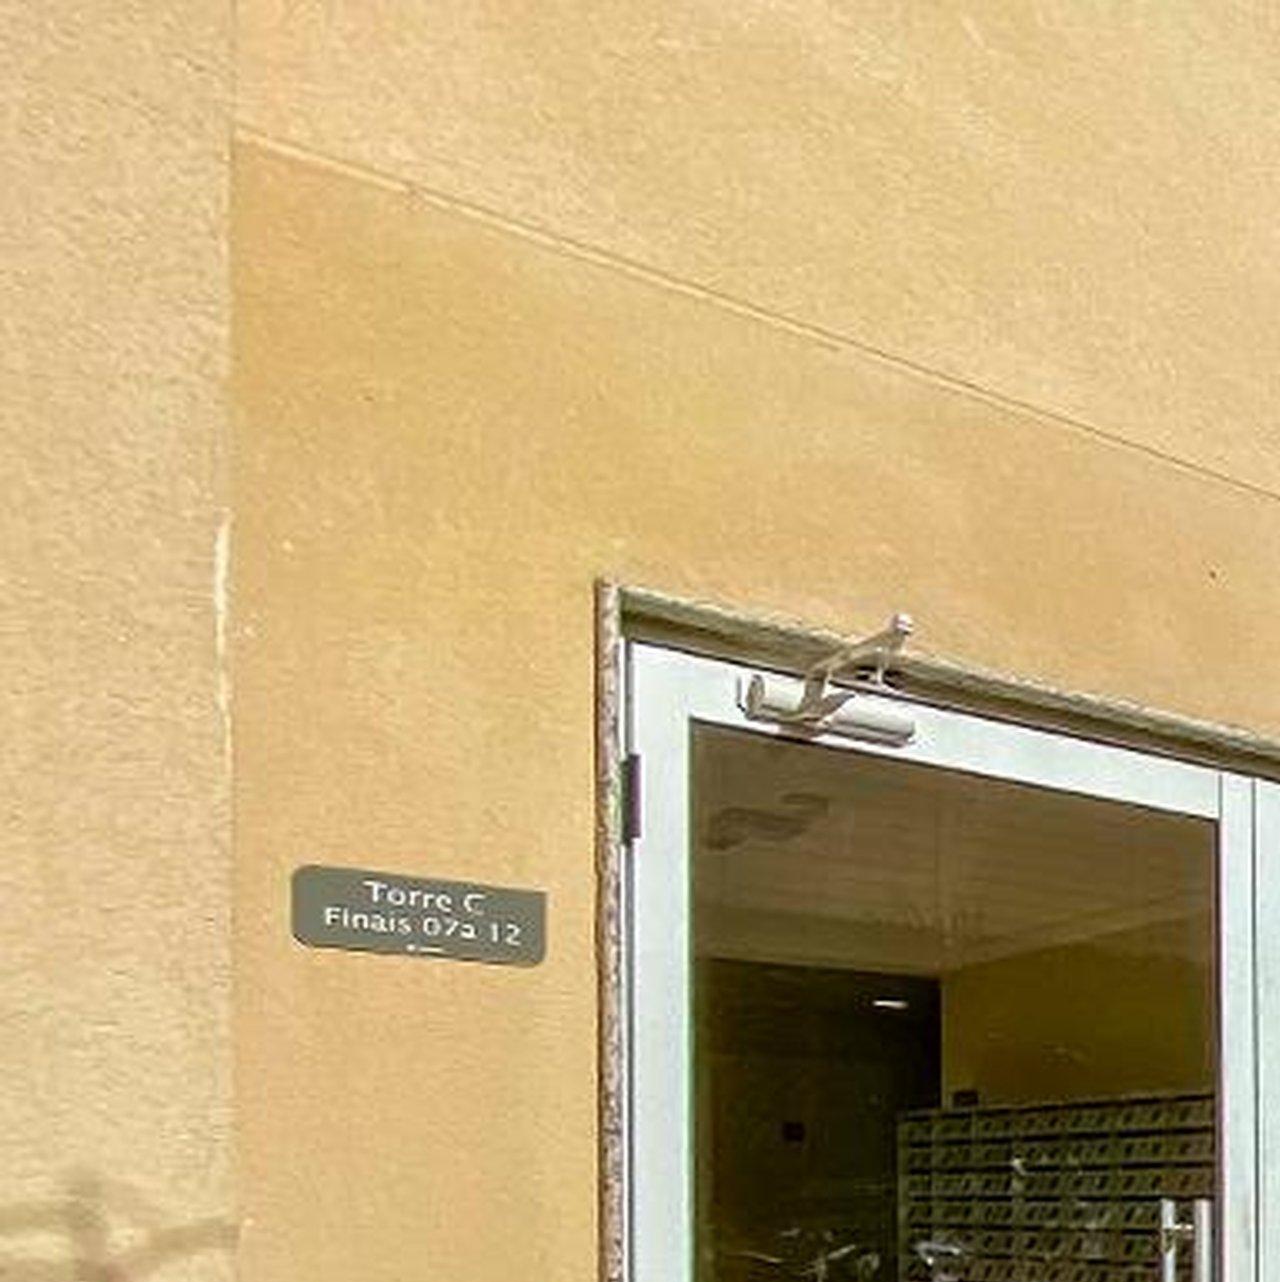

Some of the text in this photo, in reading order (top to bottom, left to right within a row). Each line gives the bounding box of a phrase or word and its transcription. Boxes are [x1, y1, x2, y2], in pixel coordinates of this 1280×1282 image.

[363, 880, 487, 916] Torre C
[324, 906, 412, 936] Finais
[490, 922, 522, 946] 12
